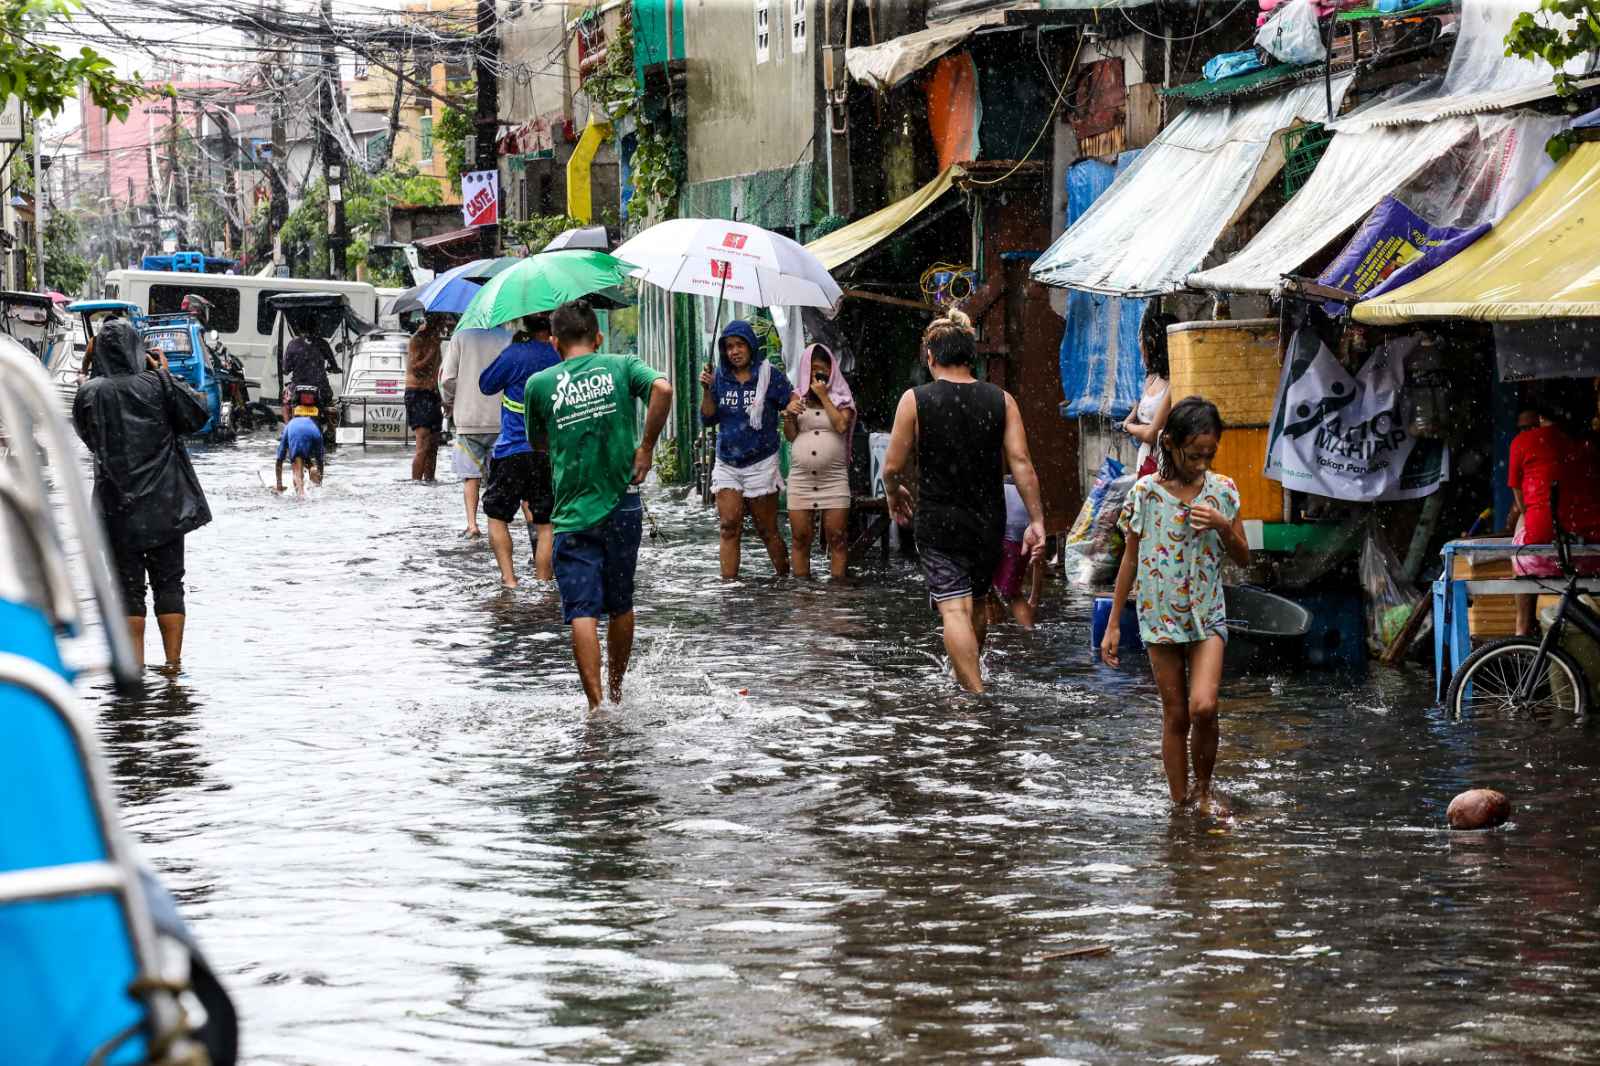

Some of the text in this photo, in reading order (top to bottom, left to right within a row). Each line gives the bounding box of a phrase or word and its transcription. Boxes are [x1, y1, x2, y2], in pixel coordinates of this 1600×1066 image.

[565, 384, 614, 406] MAHIRAP
[568, 373, 613, 396] AHON
[371, 423, 401, 433] 2398
